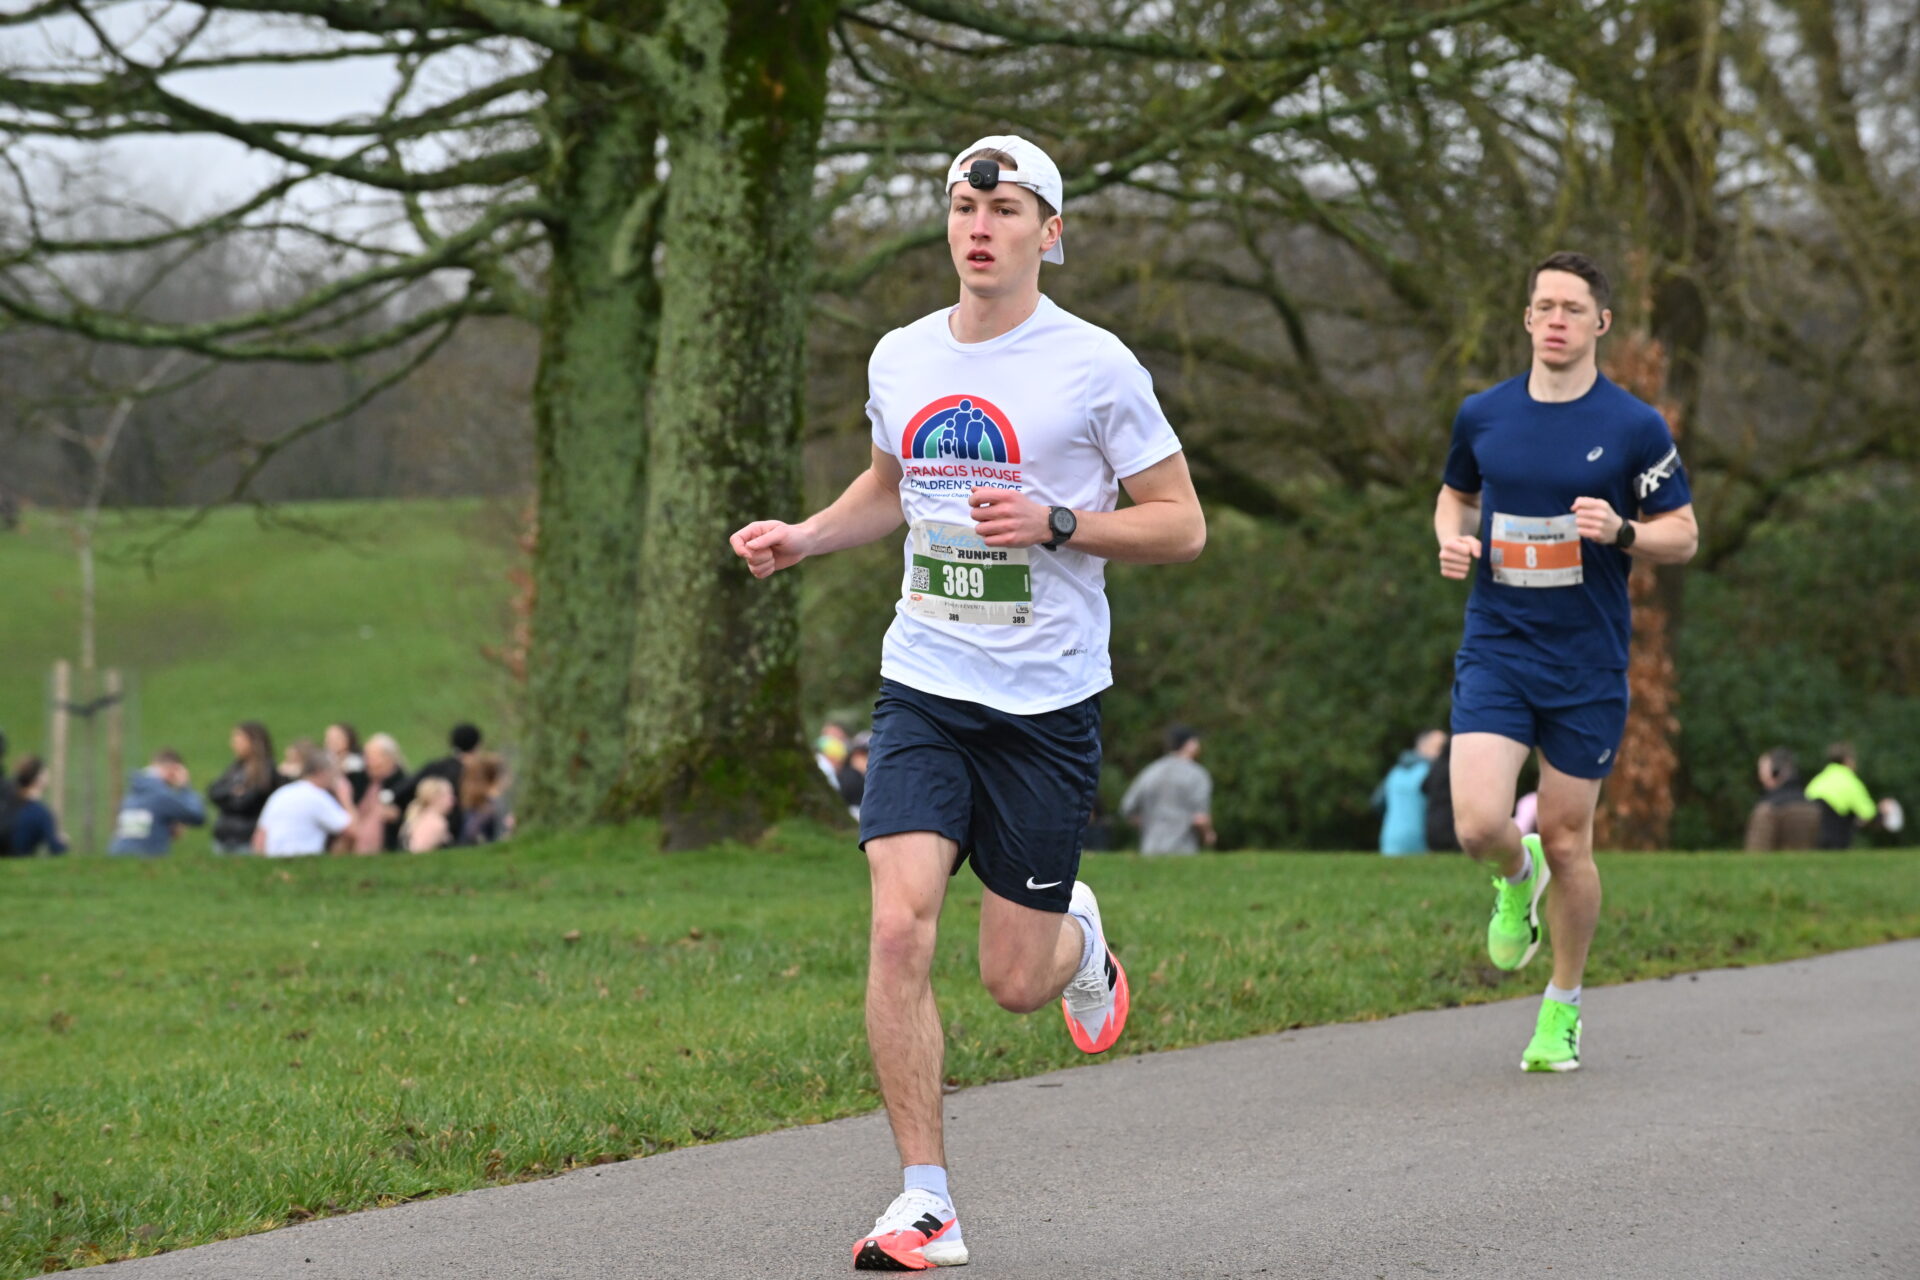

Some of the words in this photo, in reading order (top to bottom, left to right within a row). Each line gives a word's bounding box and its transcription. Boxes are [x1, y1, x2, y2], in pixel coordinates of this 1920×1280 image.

[906, 465, 968, 477] FRANCIS
[971, 466, 1022, 482] HOUSE
[910, 479, 972, 490] CHILDREN'S
[957, 549, 1008, 561] RUNNER
[1525, 545, 1538, 568] 8
[942, 564, 985, 598] 389
[949, 612, 960, 622] 389
[1012, 616, 1026, 624] 389
